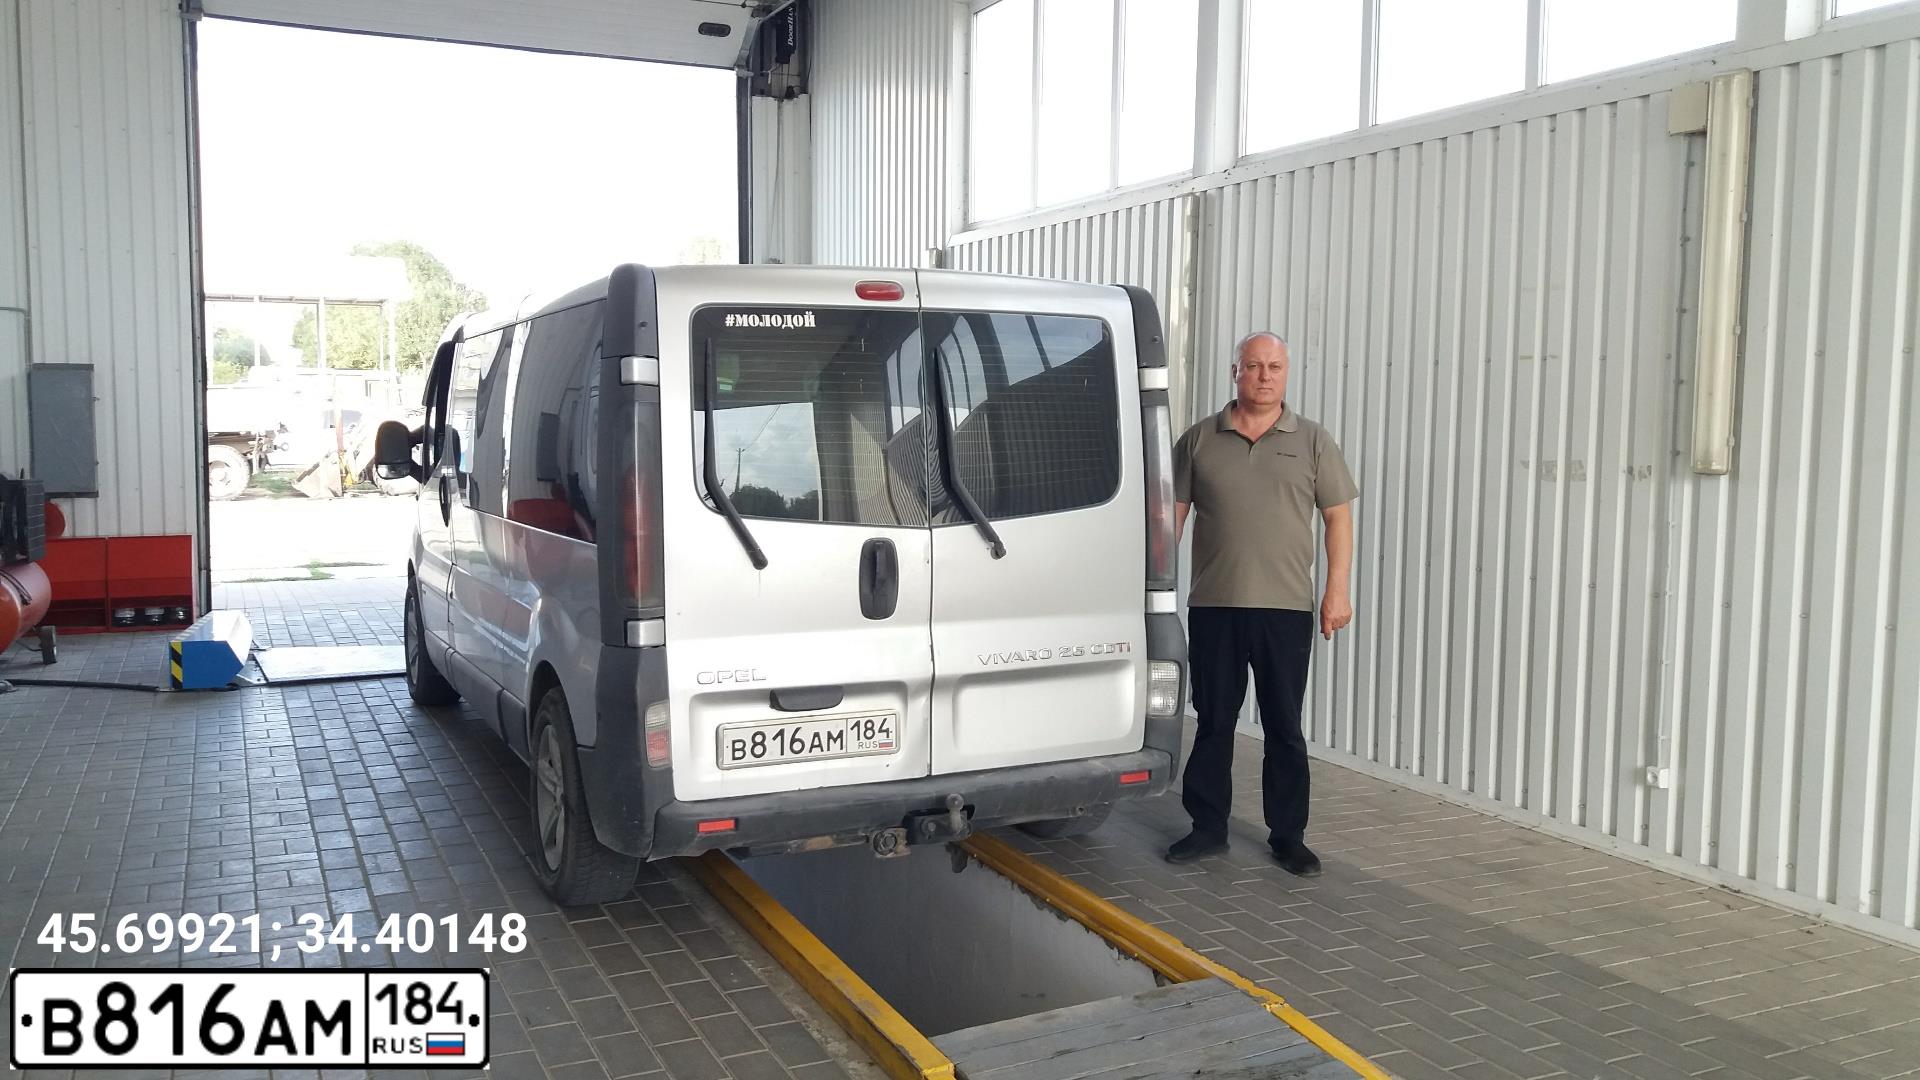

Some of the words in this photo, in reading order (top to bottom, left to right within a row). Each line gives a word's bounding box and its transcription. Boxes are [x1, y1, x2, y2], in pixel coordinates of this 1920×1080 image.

[725, 311, 816, 330] #МОЛОДОЙ
[978, 648, 1052, 666] VIVARO
[696, 669, 767, 685] OPEL
[850, 718, 890, 740] 184
[858, 741, 878, 750] RUS
